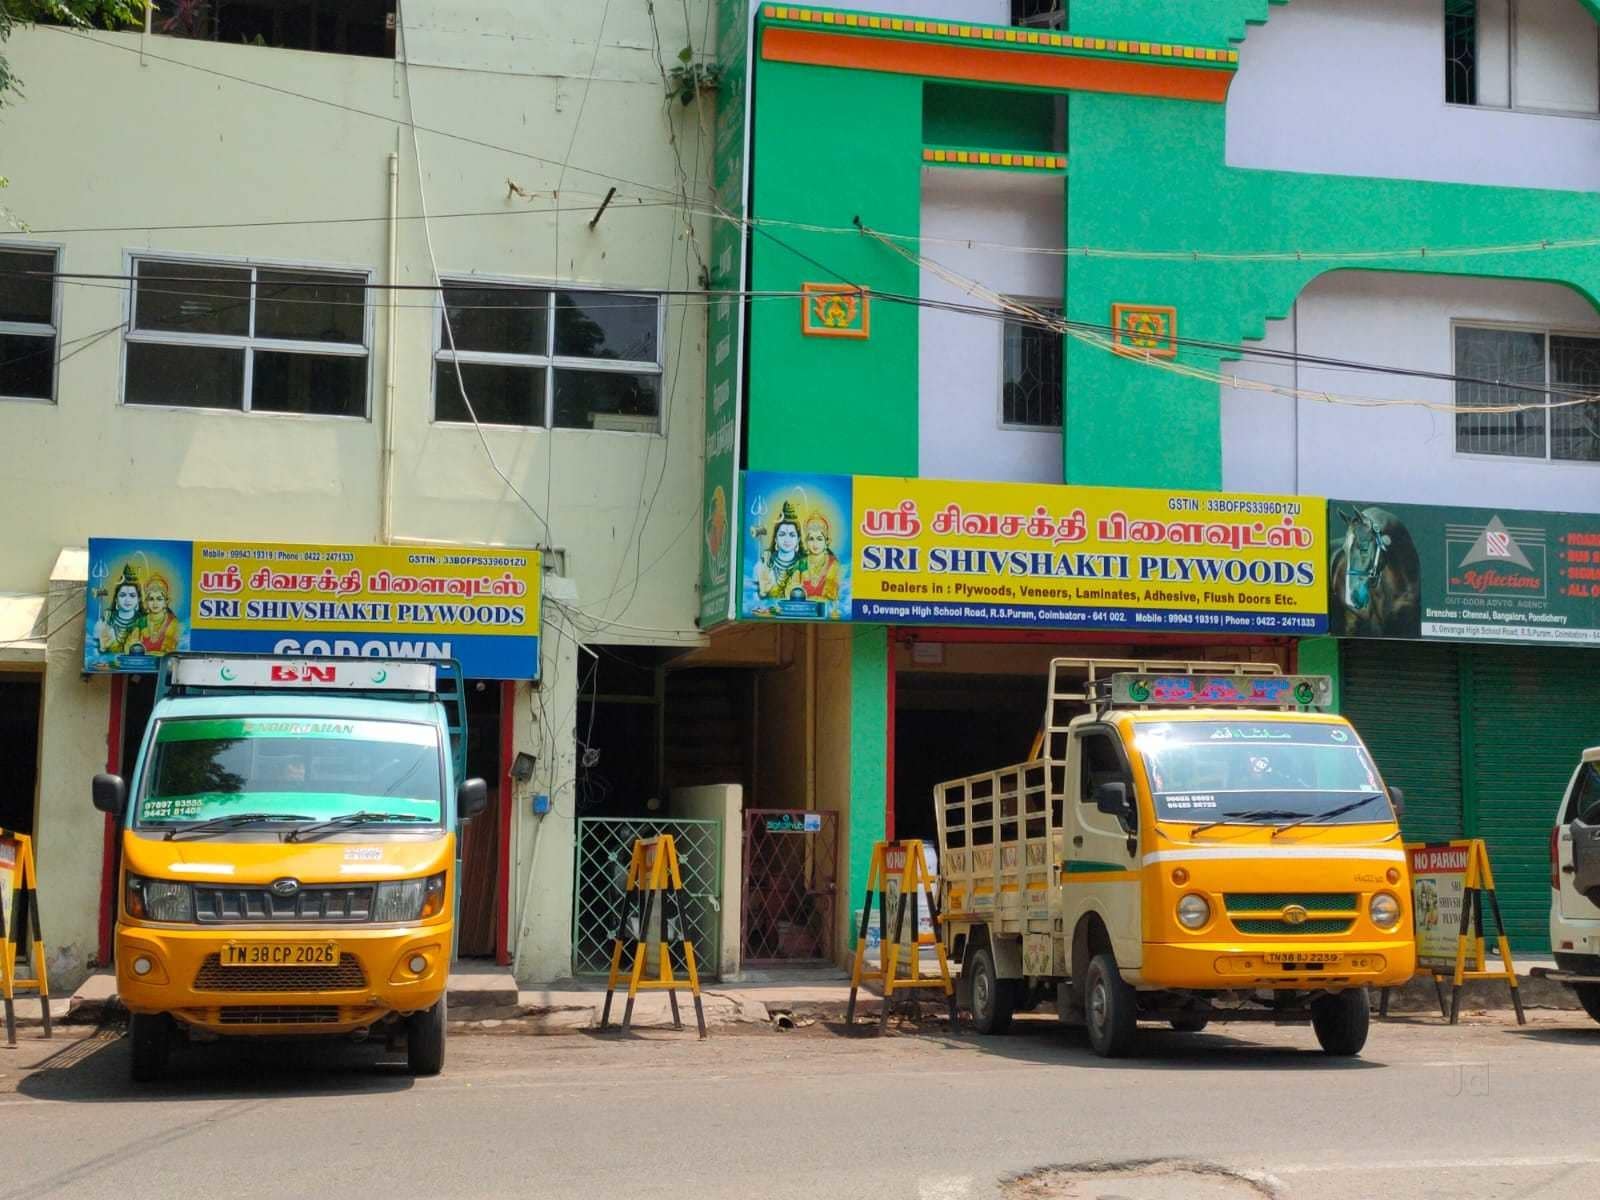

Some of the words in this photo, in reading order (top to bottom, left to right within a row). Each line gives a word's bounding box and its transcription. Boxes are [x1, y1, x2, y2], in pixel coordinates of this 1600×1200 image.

[1168, 498, 1199, 511] GSTIN
[932, 504, 1087, 545] சிவசக்தி
[1097, 511, 1313, 550] பிளைவுட்ஸ்
[203, 550, 224, 558] Mobile
[278, 552, 298, 561] Phone
[304, 552, 320, 561] 0422
[408, 555, 435, 564] GSTIN
[863, 546, 918, 570] SRI
[929, 548, 1129, 578] SHIVSHAKTI
[1140, 556, 1314, 585] PLYWOODS
[250, 567, 361, 597] சிவசக்தி
[368, 570, 526, 597] பிளைவுட்ஸ்
[881, 581, 928, 594] Dealers
[932, 582, 943, 594] in
[955, 583, 1016, 598] Plywoods,
[1020, 586, 1072, 600] Veneers,
[1076, 588, 1140, 602] Laminates,
[1144, 590, 1200, 604] Adhesive,
[1204, 592, 1235, 604] Flush
[1239, 593, 1271, 605] Doors
[1275, 594, 1297, 606] Etc.
[200, 600, 239, 618] SRI
[247, 600, 390, 621] SHIVSHAKTI
[398, 603, 524, 624] PLYWOODS
[873, 606, 910, 617] Devanga
[912, 607, 932, 617] High
[934, 607, 963, 617] School
[964, 608, 988, 618] Road,
[1039, 610, 1086, 621] Coimbatore
[1092, 612, 1107, 622] 641
[1136, 614, 1162, 623] Mobile
[1226, 616, 1250, 626] Phone
[1256, 617, 1275, 626] 0422
[1426, 608, 1457, 618] Branches
[1529, 612, 1567, 624] Pondicherry
[1414, 853, 1428, 870] NO
[1430, 851, 1470, 870] PARKIN
[229, 946, 247, 962] TN
[251, 946, 269, 962] 38
[273, 946, 291, 962] CP
[296, 945, 333, 963] 2026
